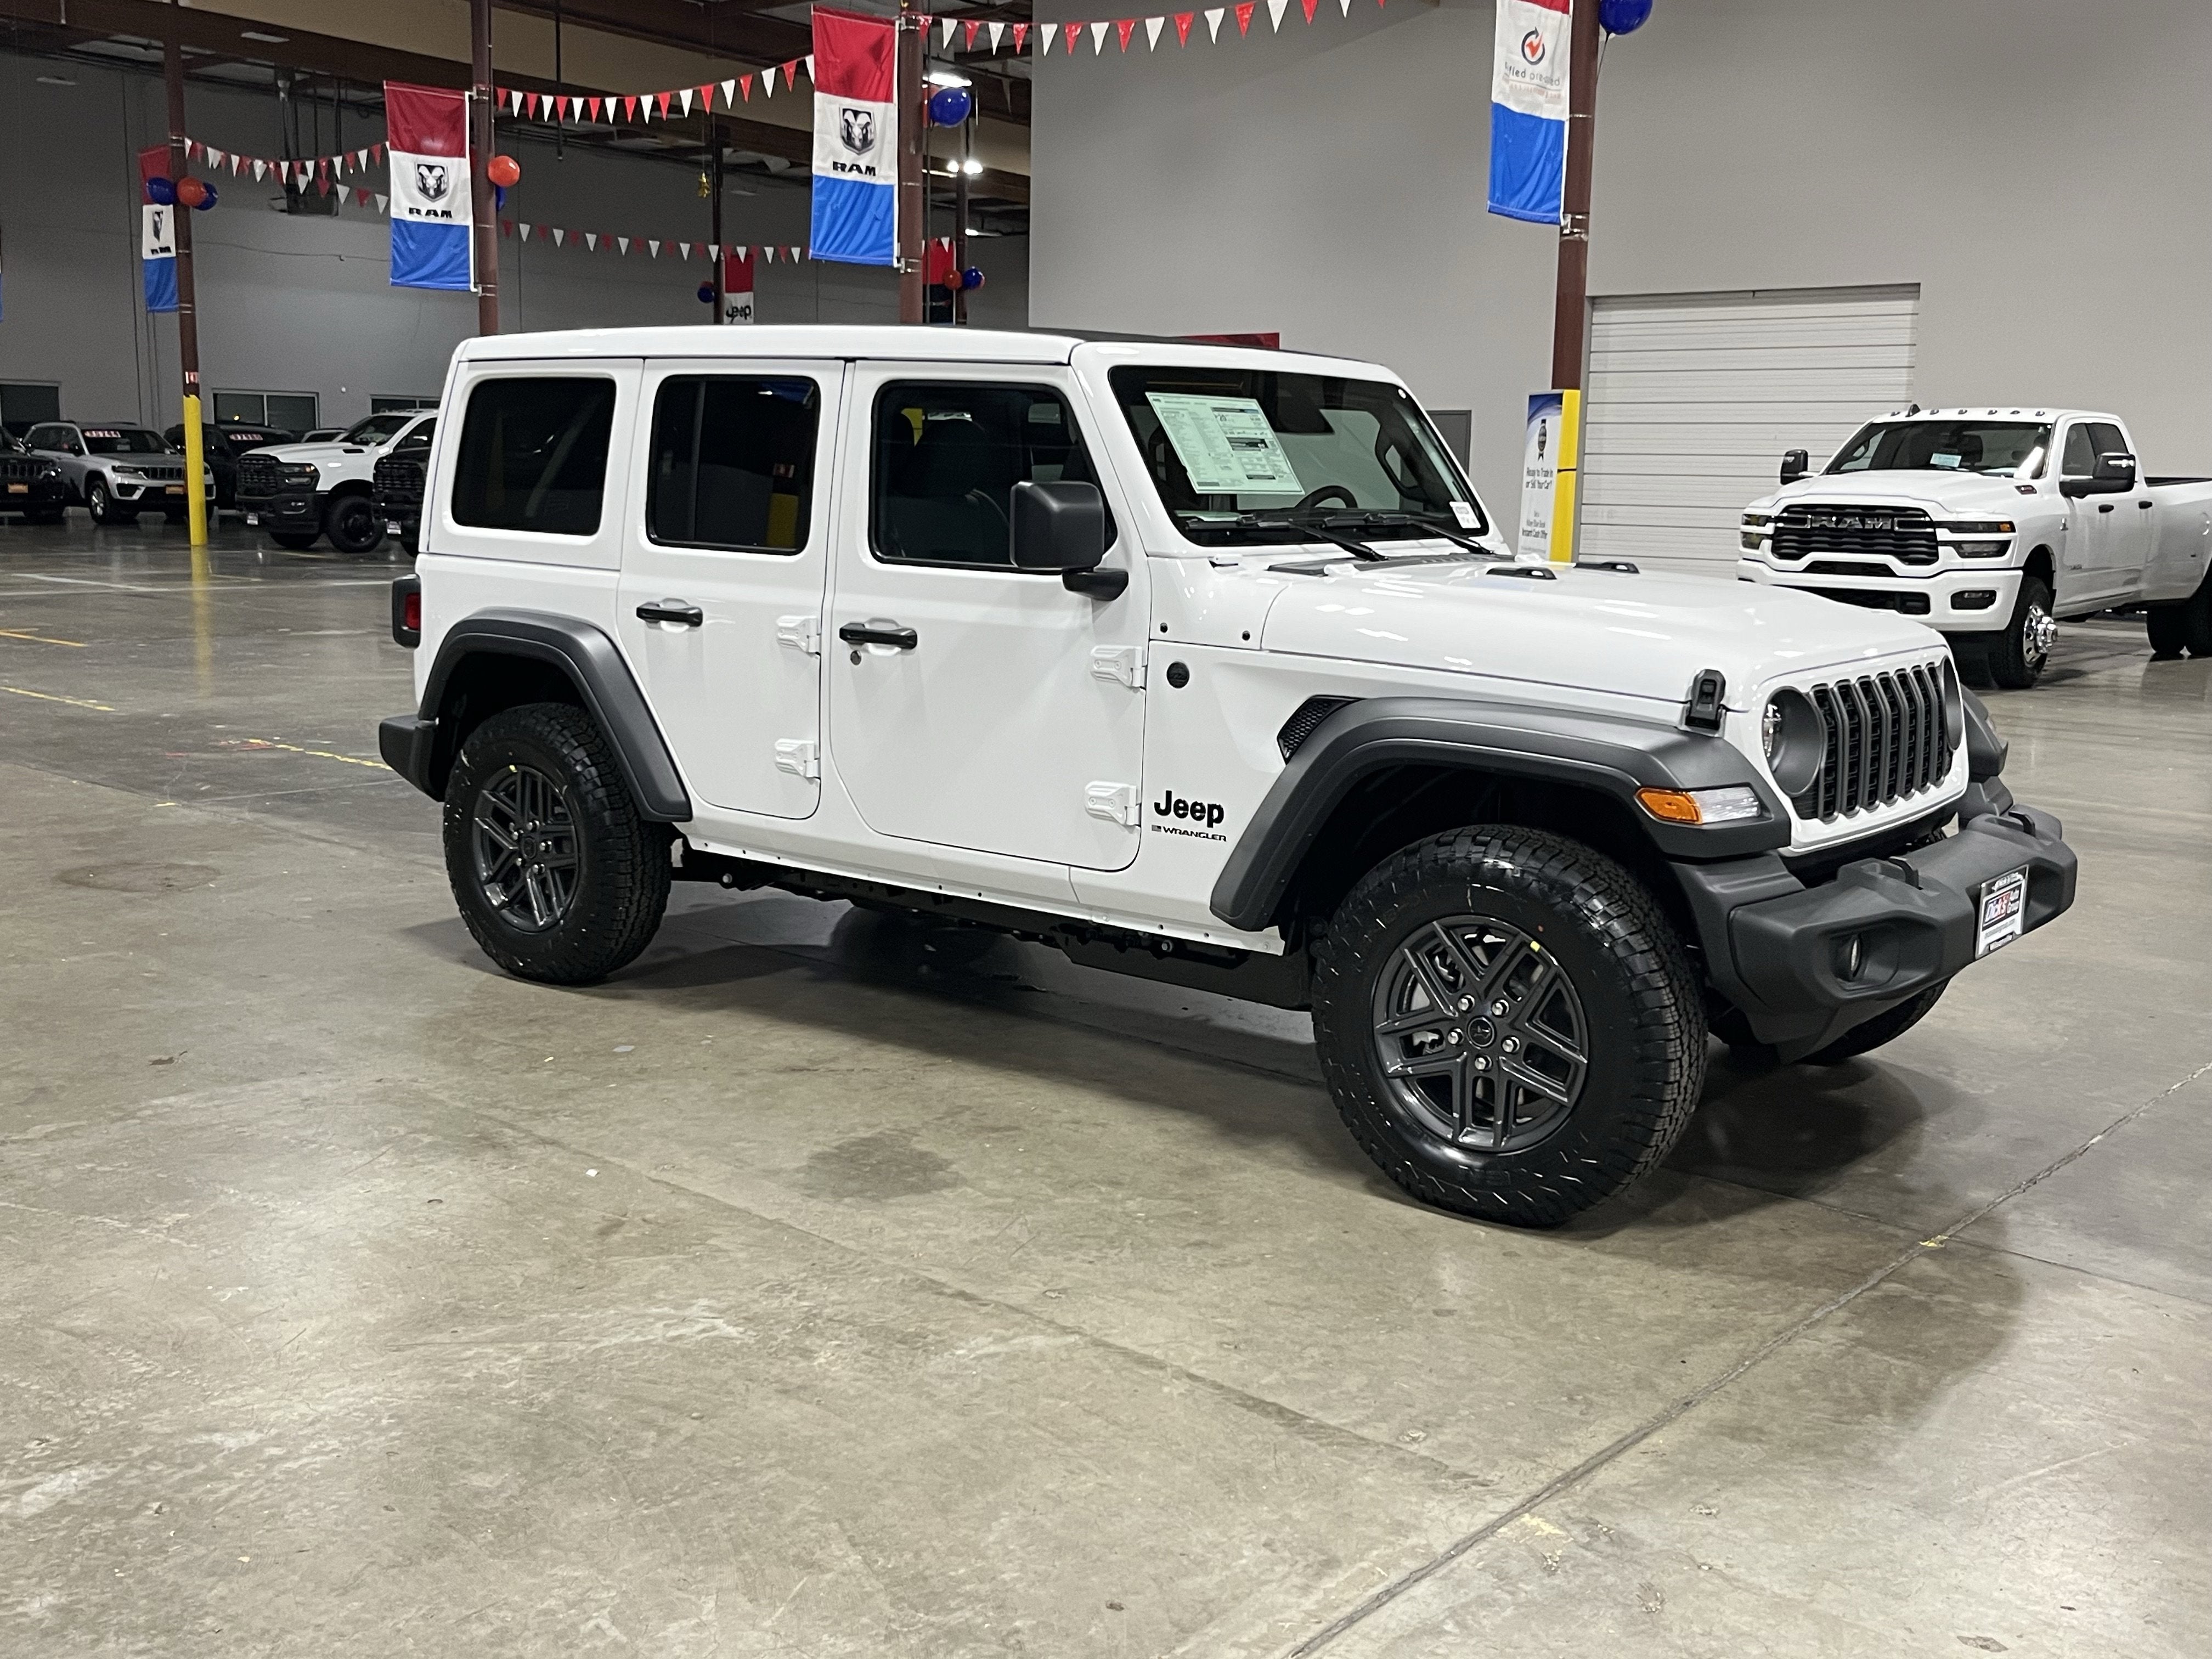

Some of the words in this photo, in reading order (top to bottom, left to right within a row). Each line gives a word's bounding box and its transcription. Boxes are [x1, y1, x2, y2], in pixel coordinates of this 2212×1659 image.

[832, 161, 876, 176] RAM
[409, 207, 453, 218] RAM
[1812, 516, 1892, 529] RAM
[1154, 790, 1224, 828] Jeep
[1163, 826, 1227, 842] WRANGLER
